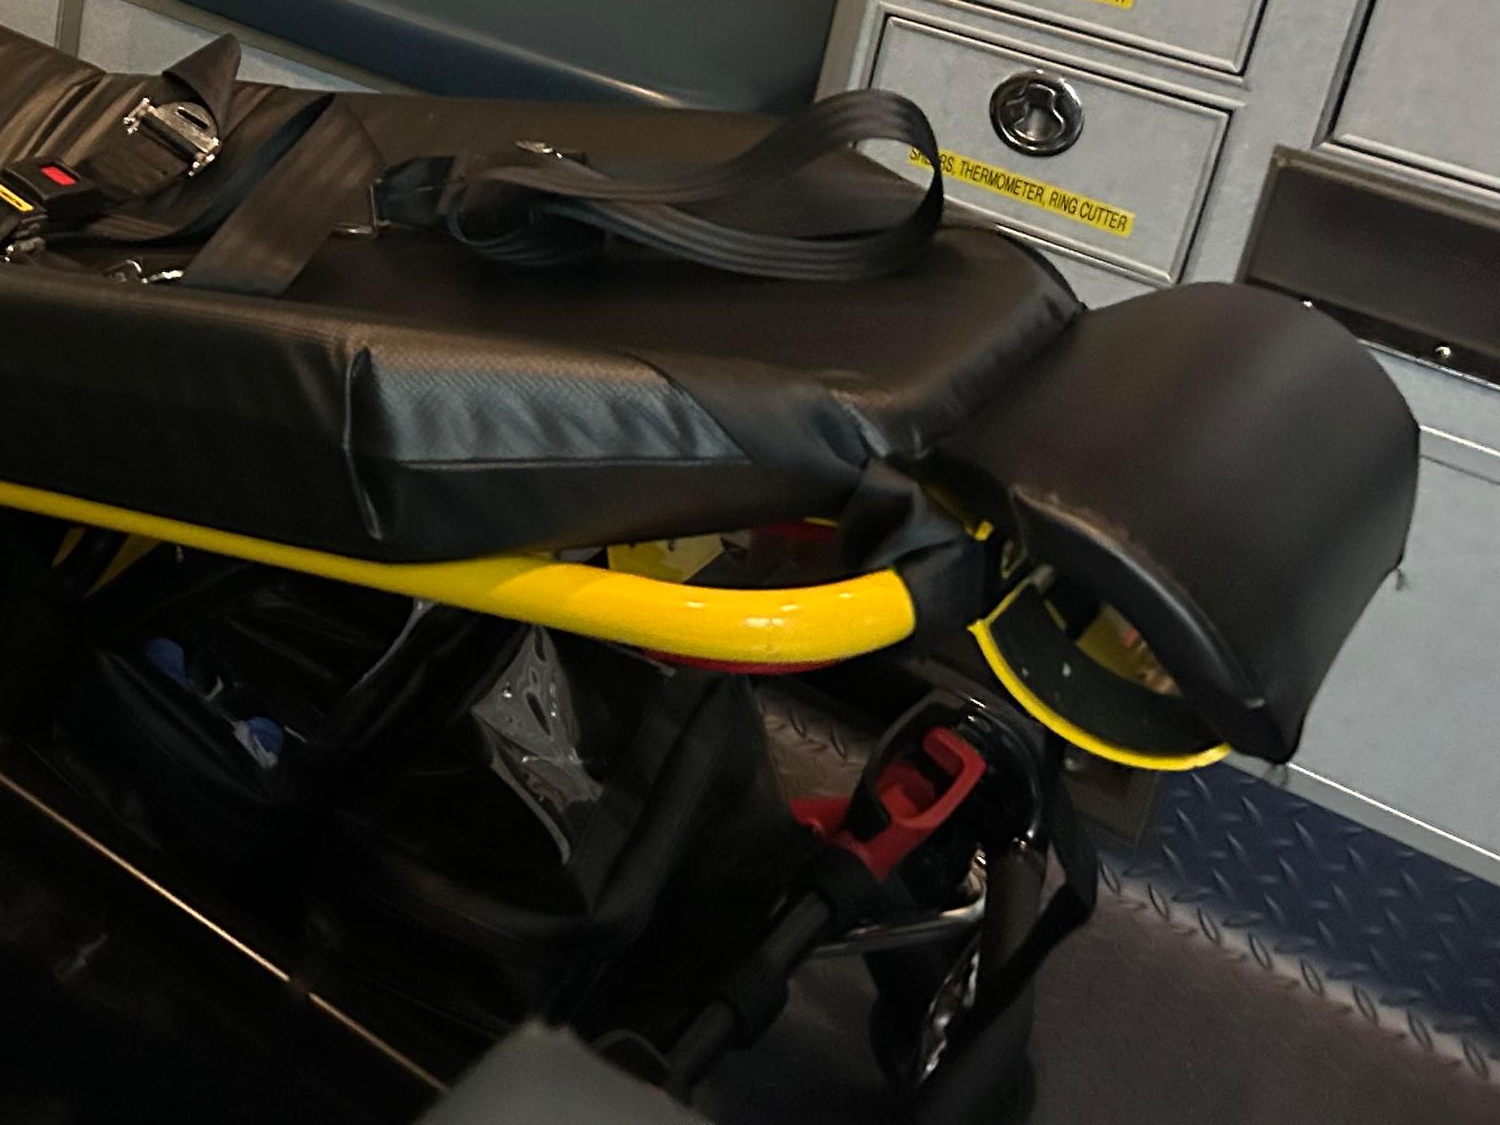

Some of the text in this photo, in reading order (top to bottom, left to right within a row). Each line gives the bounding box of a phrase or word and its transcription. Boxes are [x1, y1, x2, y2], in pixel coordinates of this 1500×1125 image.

[959, 160, 1046, 206] THERMOMETER,
[1048, 190, 1079, 214] RING
[1079, 201, 1129, 232] CUTTER
